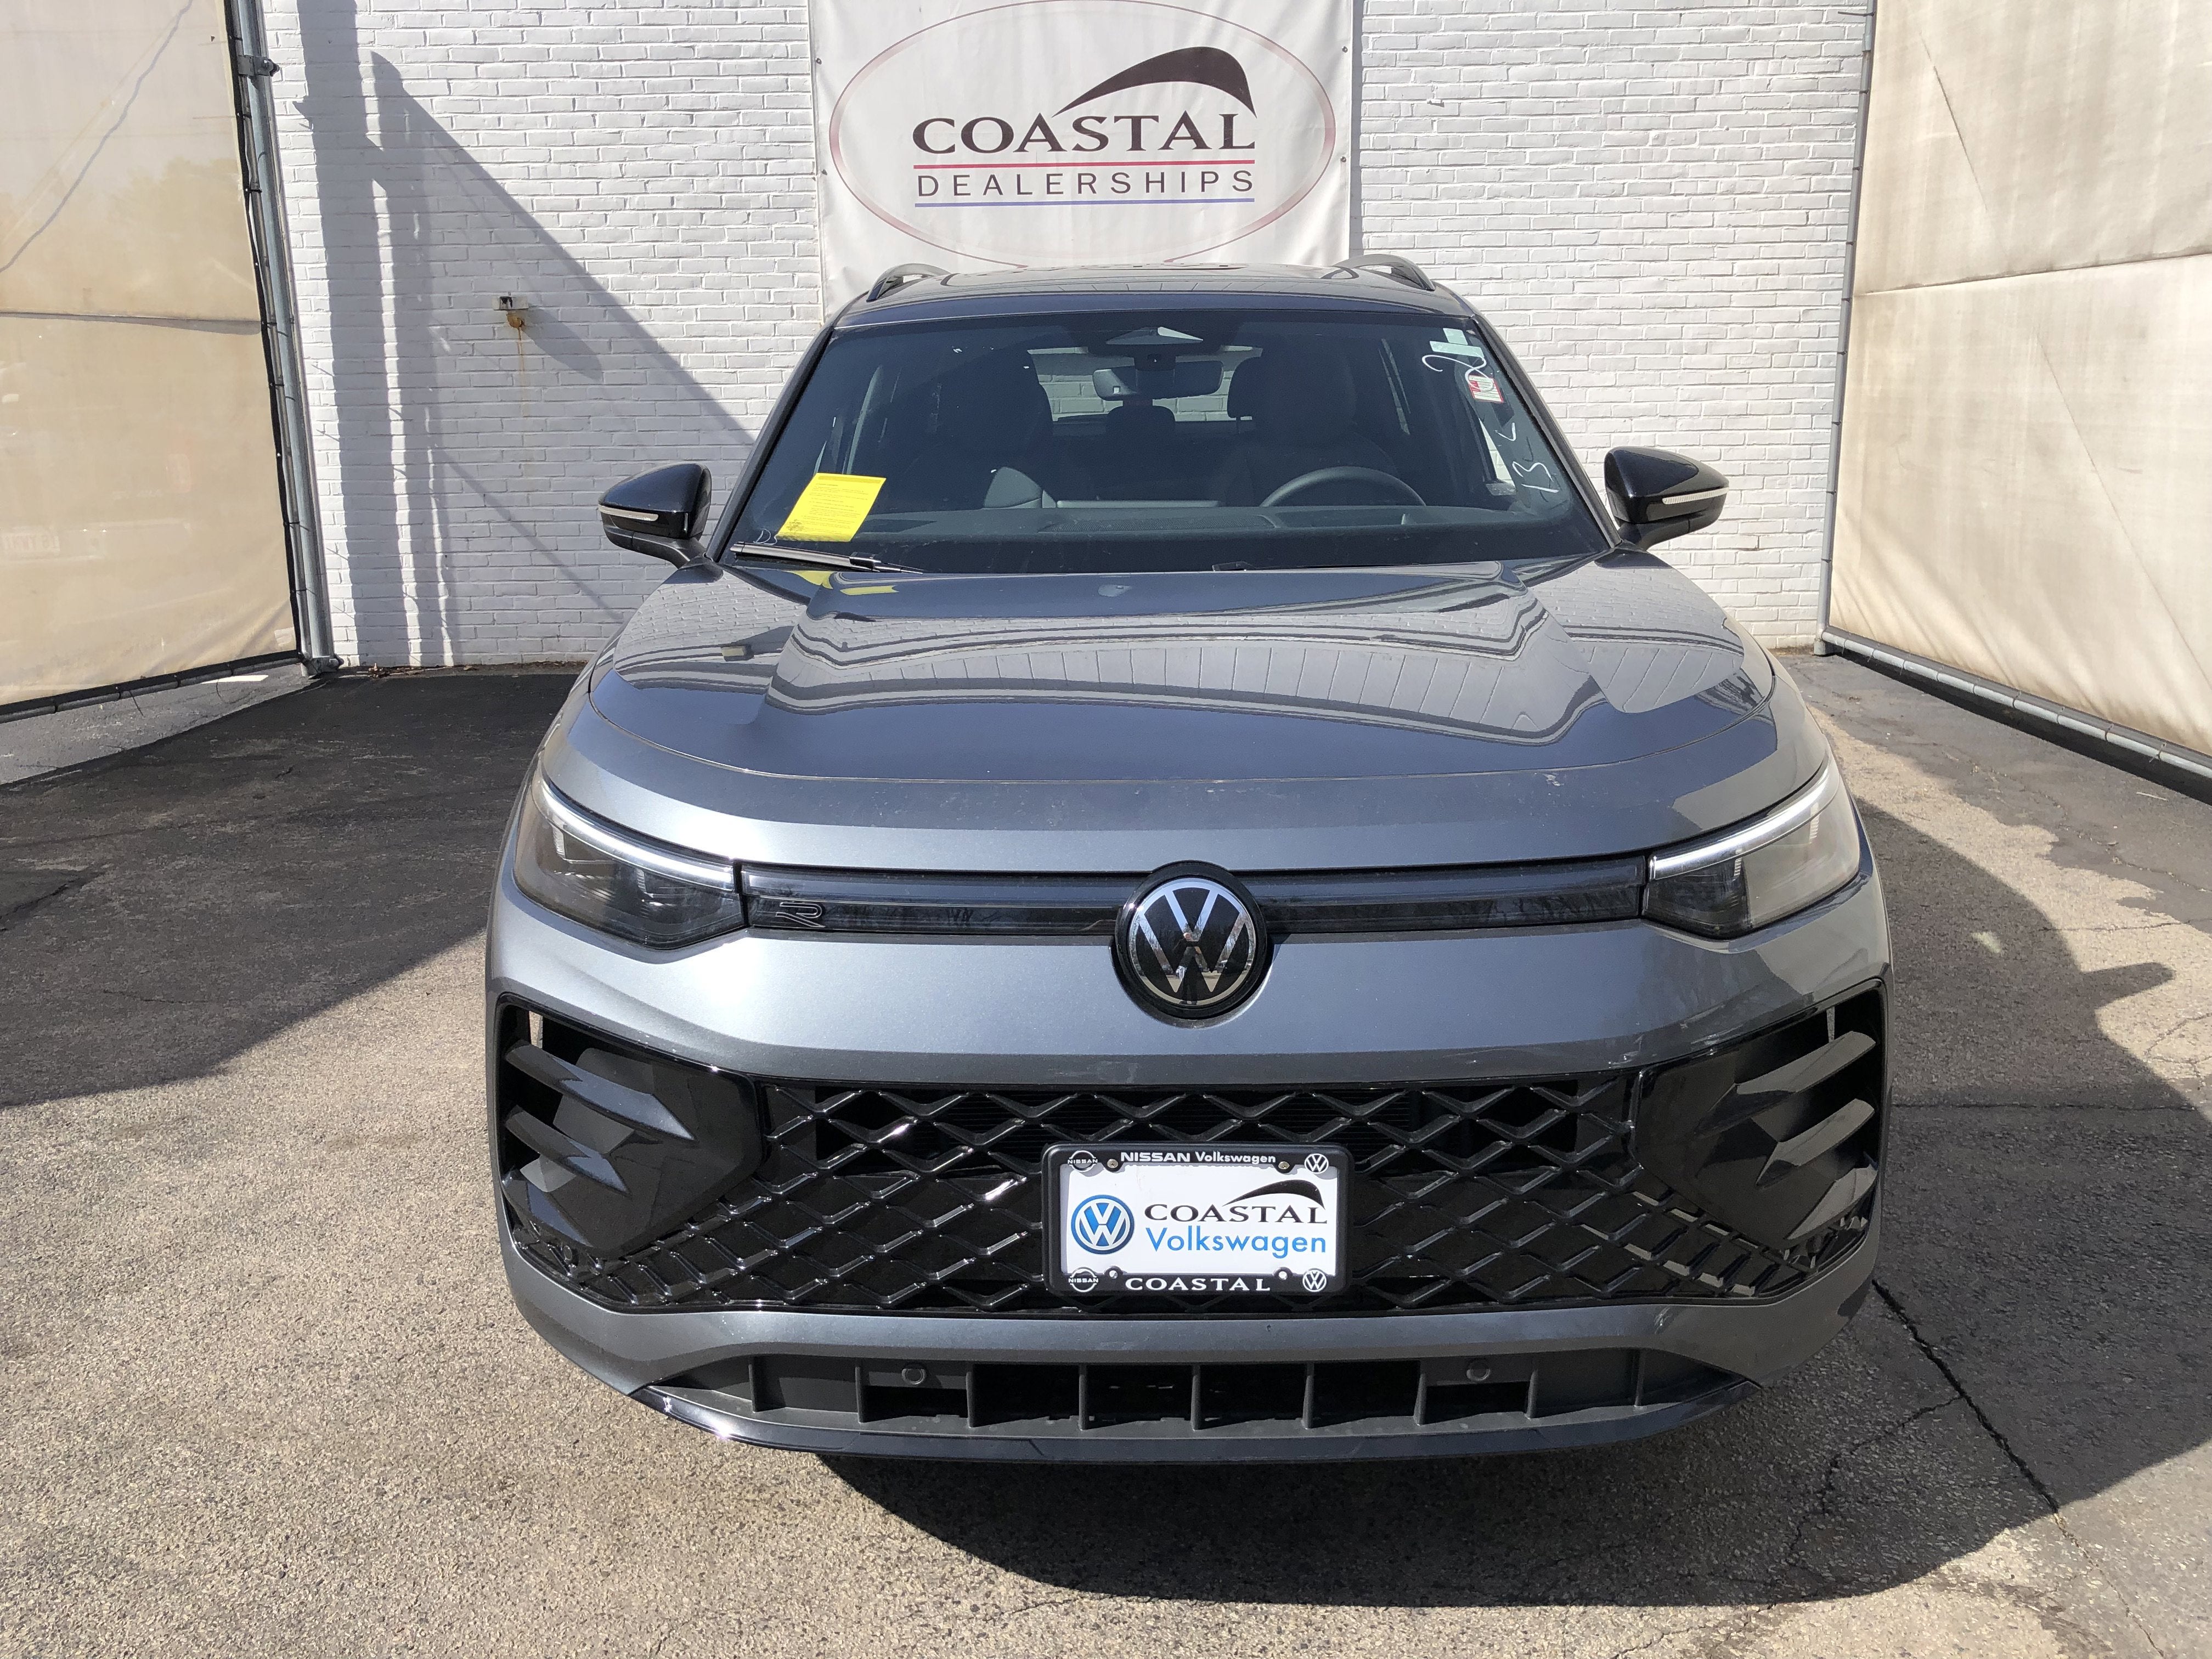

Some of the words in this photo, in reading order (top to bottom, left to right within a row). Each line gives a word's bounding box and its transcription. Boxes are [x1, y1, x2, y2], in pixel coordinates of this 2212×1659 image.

[912, 110, 1256, 154] COASTAL
[918, 170, 1253, 198] DEALERSHIPS
[775, 902, 826, 928] R
[1121, 1152, 1190, 1162] NISSAN
[1195, 1150, 1276, 1165] Volkswagen
[1144, 1204, 1328, 1223] COASTAL
[1146, 1226, 1326, 1259] Volkswagen
[1125, 1277, 1271, 1291] COASTAL
